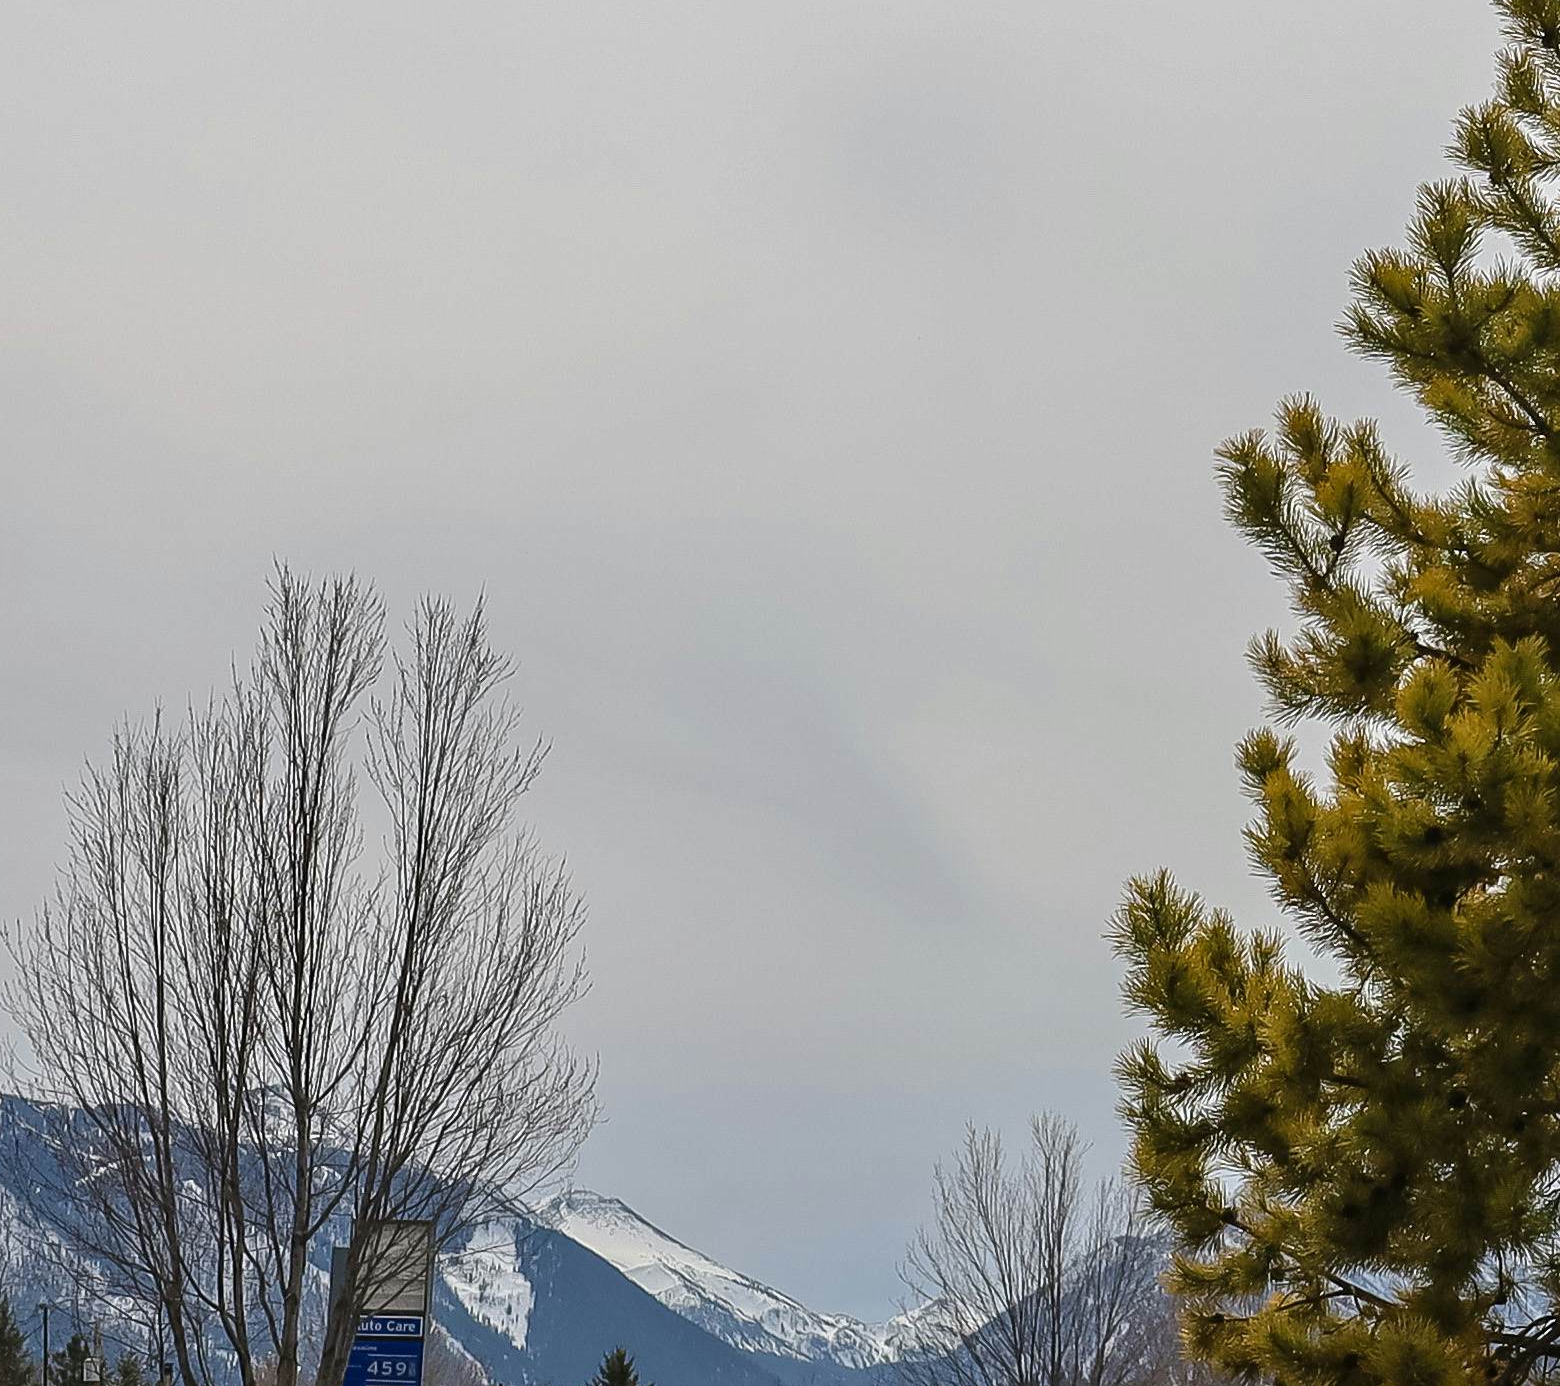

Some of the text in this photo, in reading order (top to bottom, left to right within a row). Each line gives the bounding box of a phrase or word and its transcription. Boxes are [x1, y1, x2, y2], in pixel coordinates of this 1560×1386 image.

[357, 1321, 416, 1332] uto Care
[367, 1361, 407, 1376] 459
